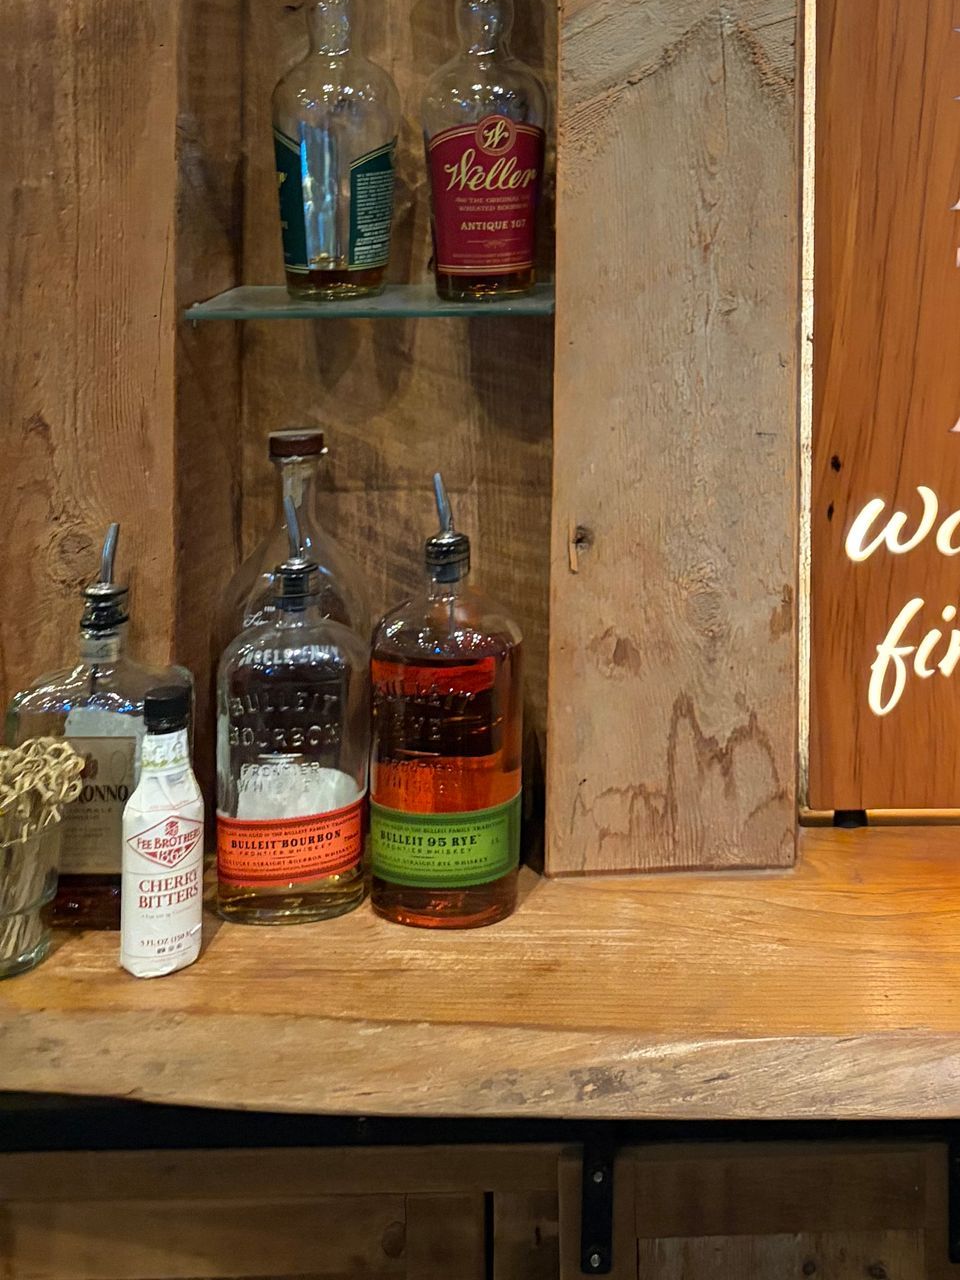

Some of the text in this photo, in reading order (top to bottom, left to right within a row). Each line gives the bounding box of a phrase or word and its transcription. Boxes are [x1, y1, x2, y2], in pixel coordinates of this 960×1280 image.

[444, 148, 538, 192] Weller
[460, 220, 508, 232] ANTIQUE
[136, 837, 152, 849] FEE
[231, 829, 341, 850] BULLEIT BOURBON
[380, 830, 477, 847] BULLEIT 95 RYE
[288, 842, 332, 855] WHISKEY
[426, 847, 472, 855] WHISKEY
[139, 870, 198, 893] CHERRY
[138, 881, 199, 909] BITTERS
[157, 936, 169, 946] OZ
